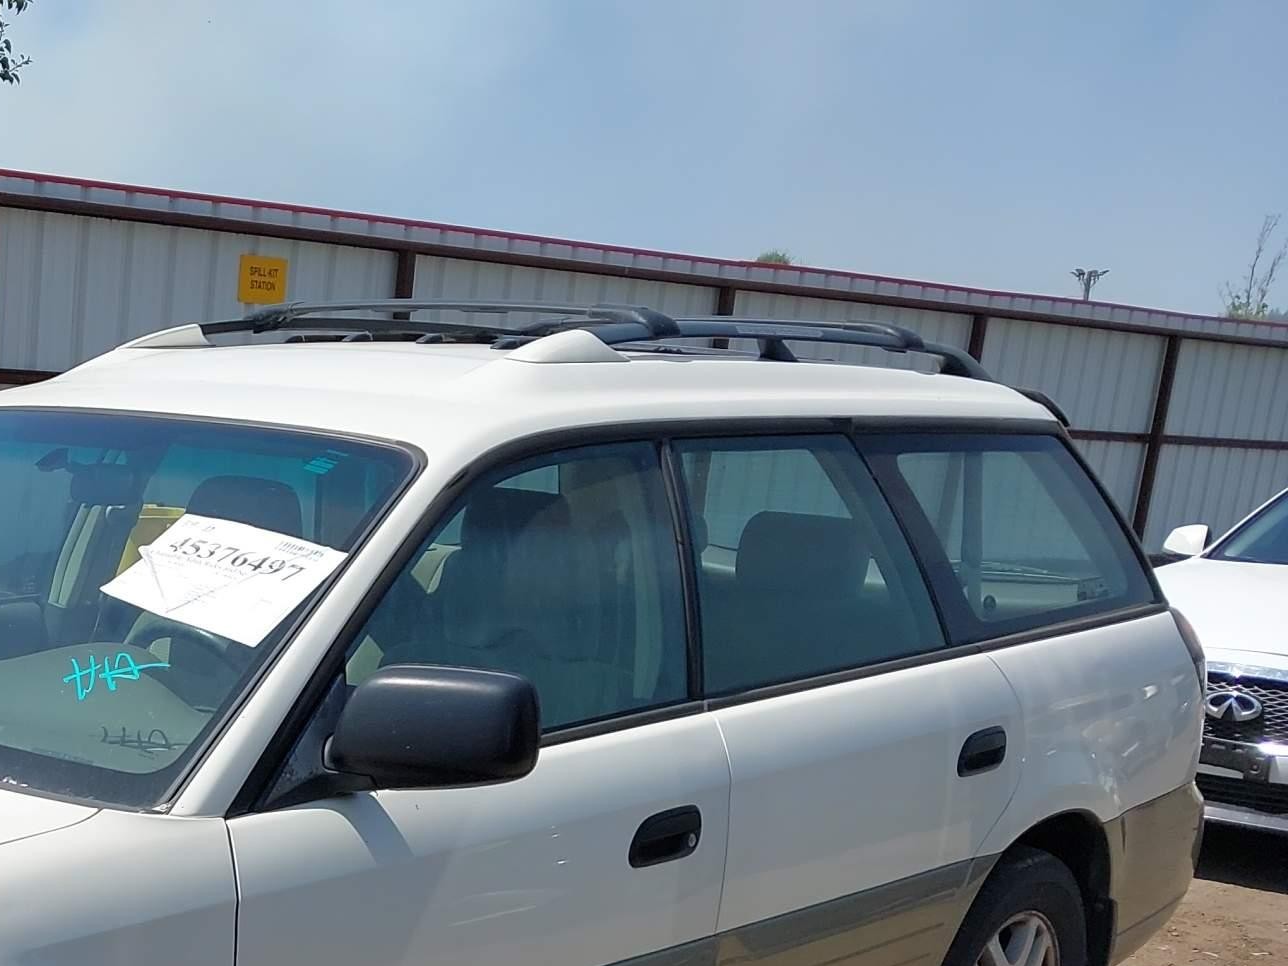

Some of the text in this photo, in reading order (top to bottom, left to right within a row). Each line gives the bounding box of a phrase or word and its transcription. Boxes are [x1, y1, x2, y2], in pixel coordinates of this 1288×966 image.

[249, 265, 279, 278] SPILL KIT
[250, 279, 276, 291] STATION
[169, 537, 306, 581] 45376497
